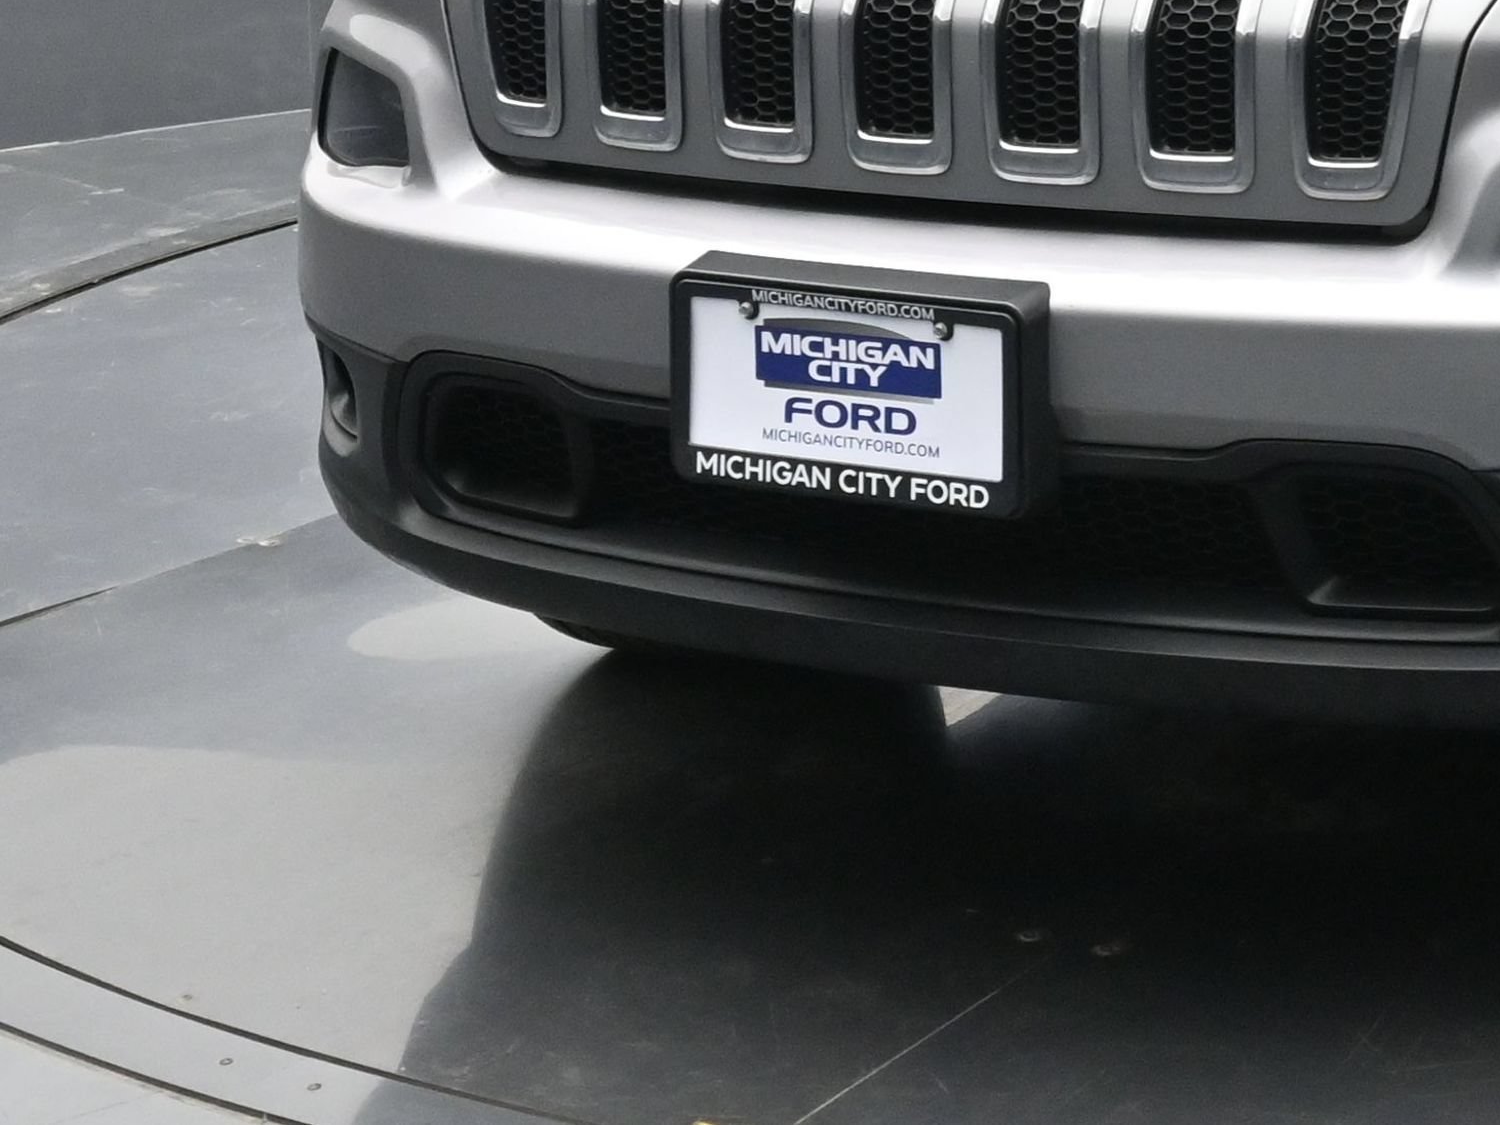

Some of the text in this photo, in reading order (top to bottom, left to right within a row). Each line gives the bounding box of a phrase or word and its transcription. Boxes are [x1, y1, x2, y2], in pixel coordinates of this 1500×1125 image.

[752, 290, 934, 321] MICHIGANCITYFORD.COM
[761, 331, 935, 369] MICHIGAN
[808, 360, 887, 386] CITY
[784, 397, 917, 435] FORD
[762, 428, 940, 458] MICHIGANCITYFORD.COM
[696, 451, 989, 509] MICHIGAN CITY FORD
